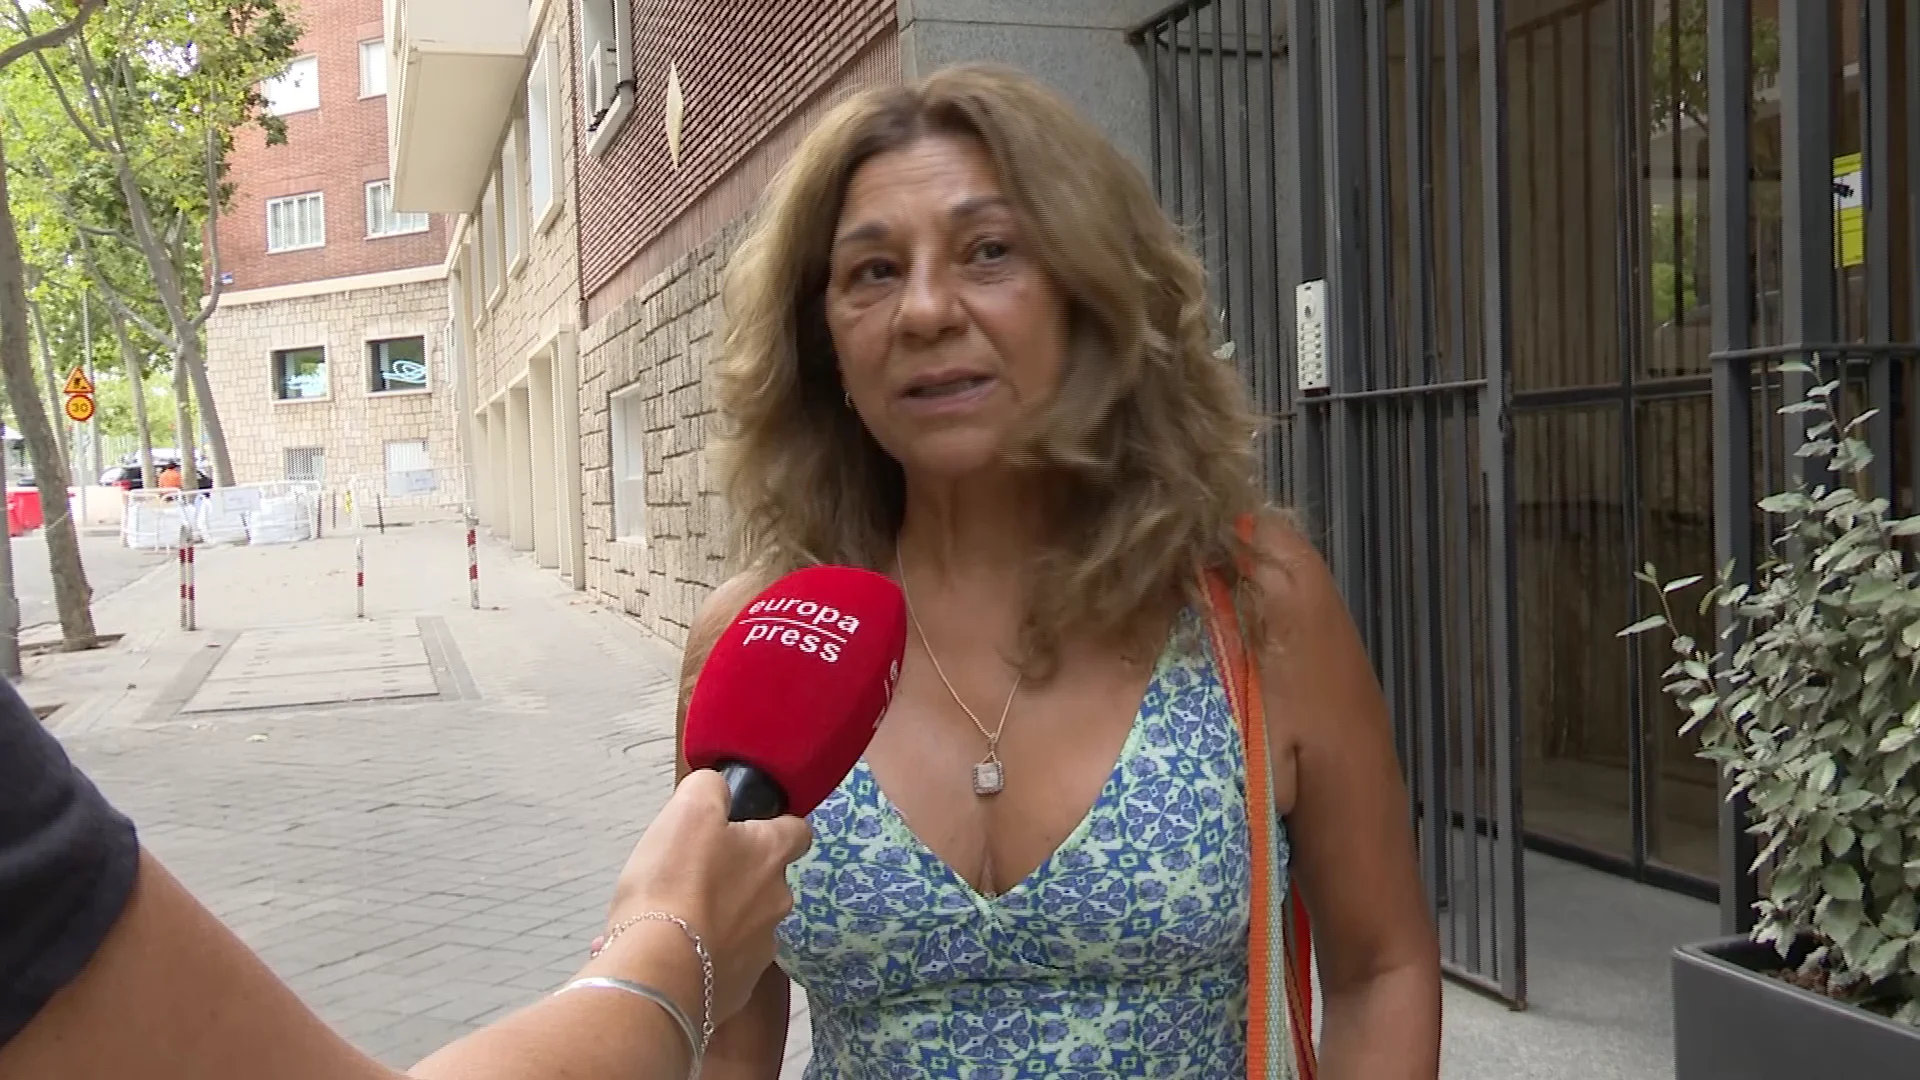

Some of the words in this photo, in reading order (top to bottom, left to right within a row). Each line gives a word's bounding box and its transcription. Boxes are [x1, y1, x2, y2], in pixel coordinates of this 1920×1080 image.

[71, 402, 89, 413] 30
[748, 598, 860, 634] europa
[743, 624, 841, 662] press
